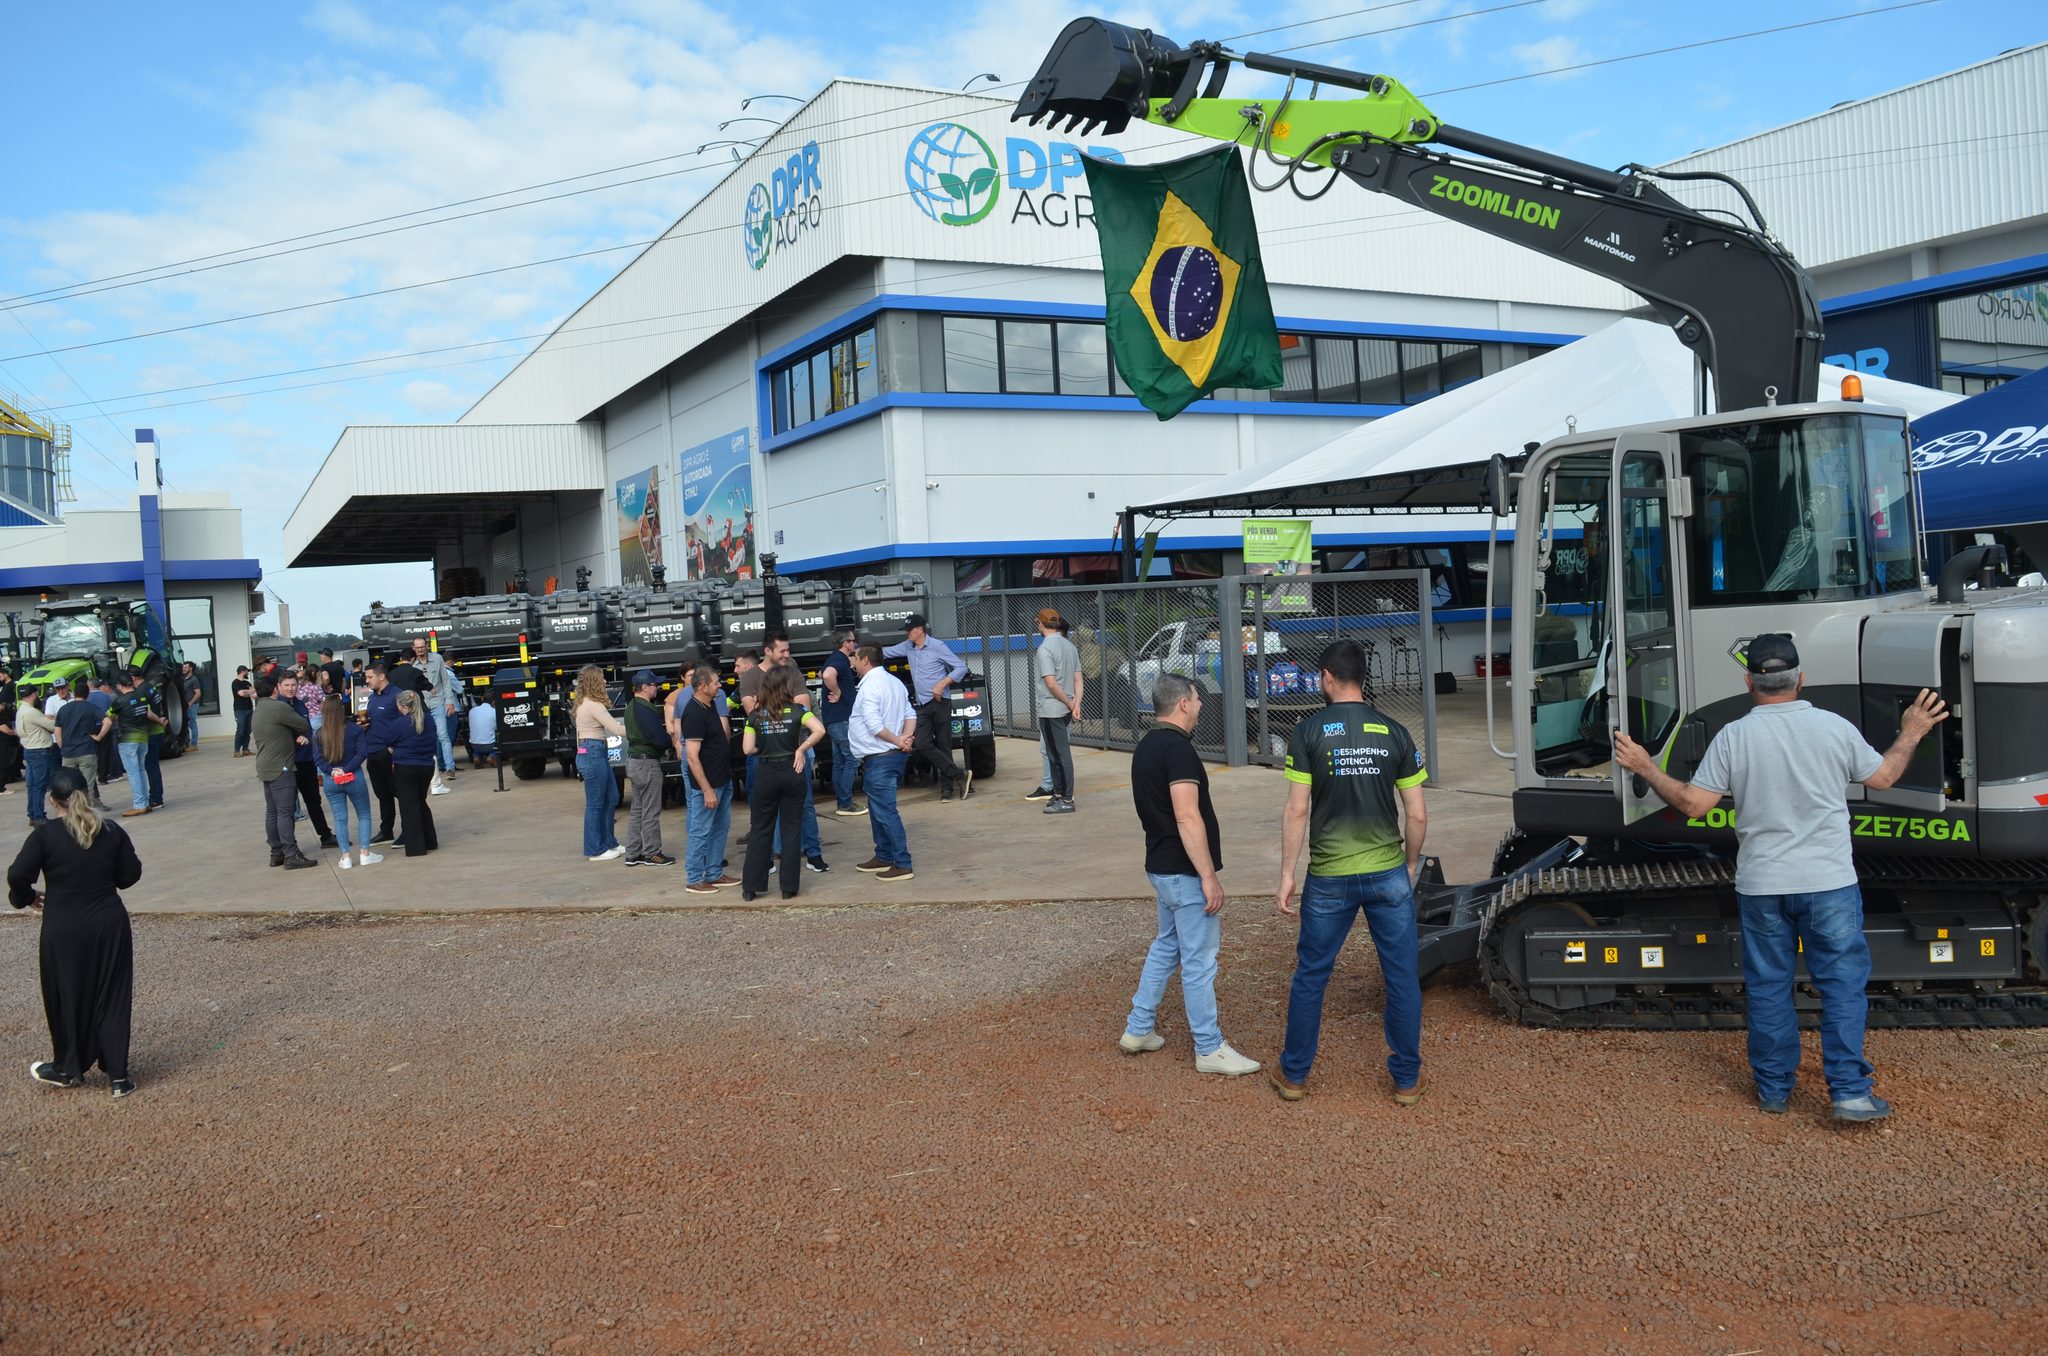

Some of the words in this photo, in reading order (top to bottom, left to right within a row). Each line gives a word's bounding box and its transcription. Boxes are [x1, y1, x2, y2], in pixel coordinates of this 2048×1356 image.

[771, 140, 822, 221] DPR
[1429, 175, 1561, 230] ZOOMLION
[1011, 190, 1099, 228] AGR
[775, 194, 821, 255] AGRO
[1584, 236, 1636, 262] MANTOMAC
[1957, 444, 2048, 468] AGR
[1247, 525, 1258, 535] PÓS
[1259, 527, 1278, 535] VENDA
[551, 616, 588, 625] PLANTIO
[788, 616, 825, 627] PLUS
[554, 624, 587, 633] DIRETO
[638, 623, 684, 634] PLANTIO
[643, 632, 682, 643] DIRETO
[1323, 722, 1345, 732] DPR
[1333, 747, 1389, 757] DESEMPENHO
[1334, 757, 1374, 766] POTÊNCIA
[1335, 767, 1380, 776] RESULTADO
[1853, 815, 1972, 842] ZE75GA
